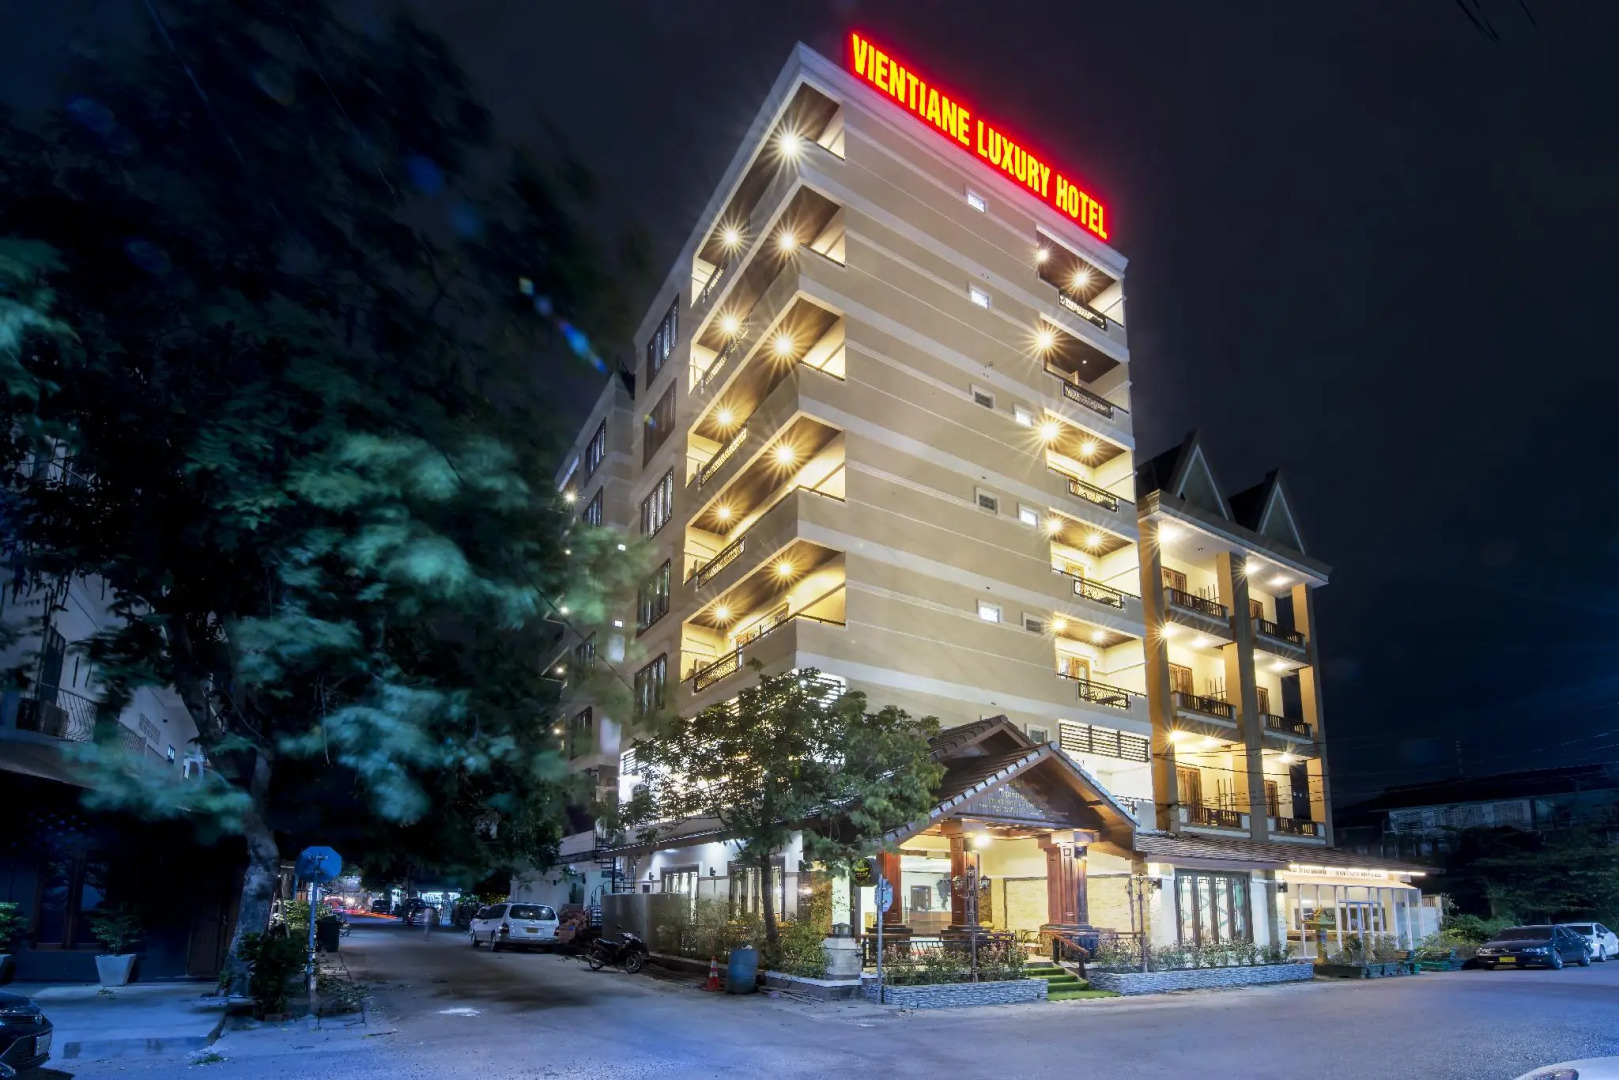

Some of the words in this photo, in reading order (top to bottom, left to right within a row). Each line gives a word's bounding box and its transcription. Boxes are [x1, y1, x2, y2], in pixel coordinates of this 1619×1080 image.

[852, 33, 970, 146] VIENTIANE
[977, 120, 1051, 197] LUXURY
[1055, 174, 1107, 240] HOTEL
